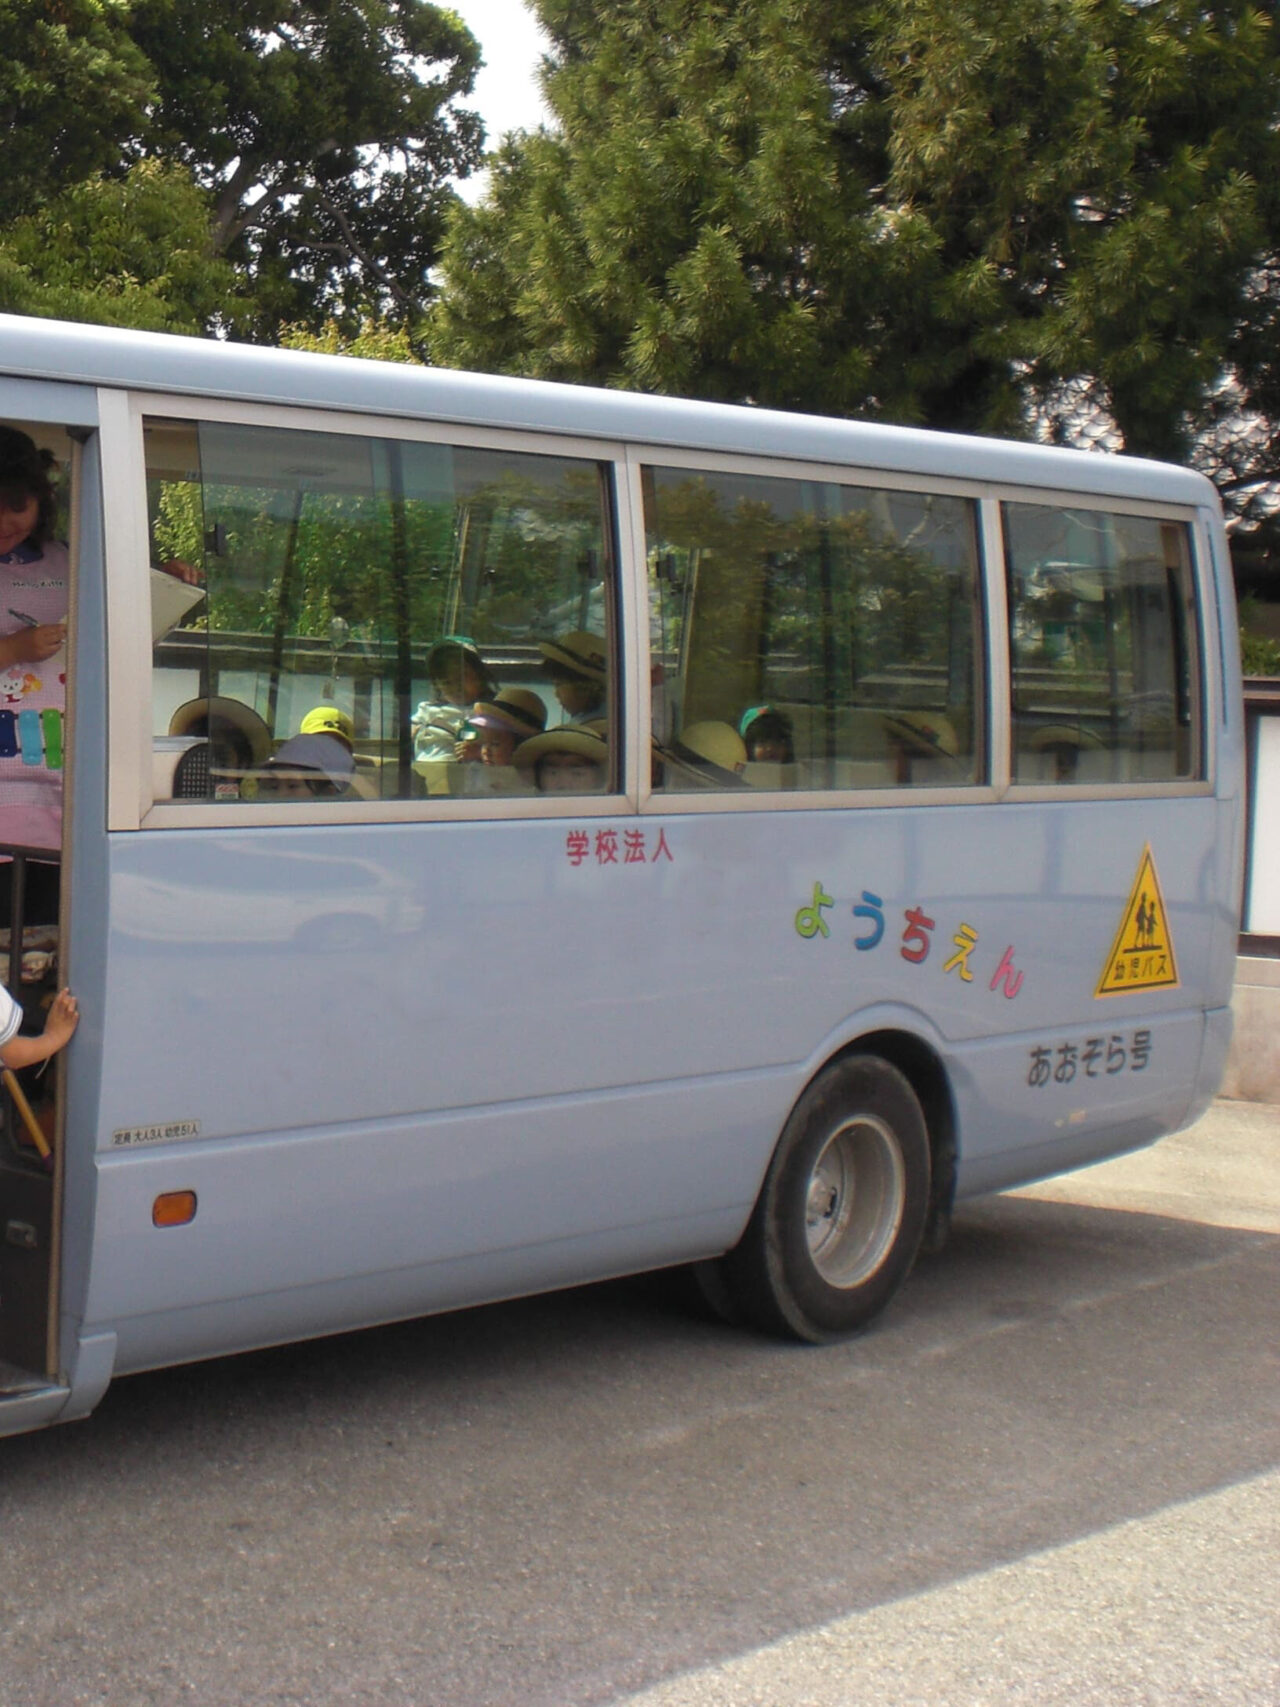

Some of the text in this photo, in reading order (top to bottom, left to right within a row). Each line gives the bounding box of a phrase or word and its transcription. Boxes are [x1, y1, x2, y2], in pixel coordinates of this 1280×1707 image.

[566, 827, 674, 866] 学校法人
[794, 881, 1024, 999] ようちえん
[1028, 1030, 1152, 1088] あおそら号
